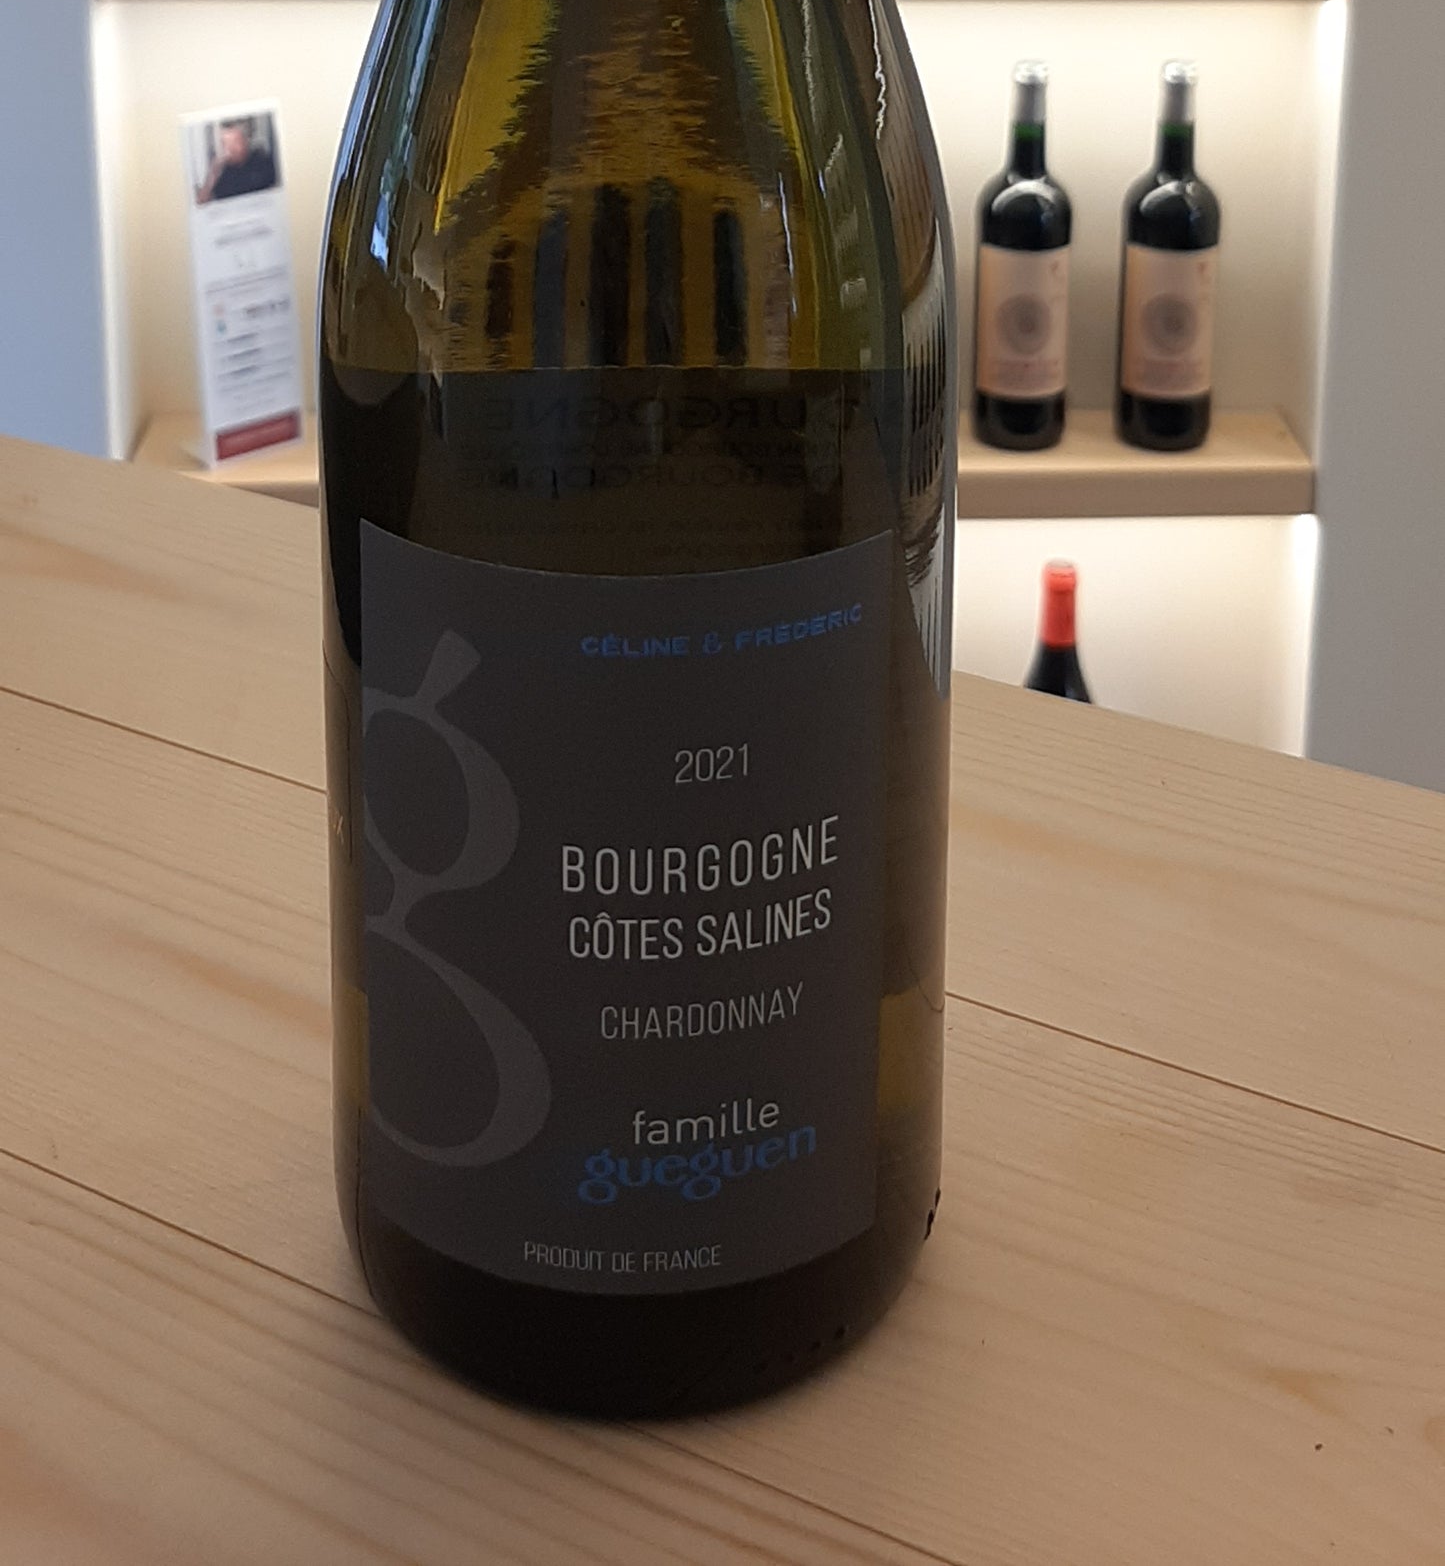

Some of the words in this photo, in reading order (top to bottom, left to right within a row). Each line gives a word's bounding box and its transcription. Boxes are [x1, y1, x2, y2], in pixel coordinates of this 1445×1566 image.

[674, 742, 748, 784] 2021
[561, 814, 839, 896] BOURGOGNE
[568, 911, 683, 960] CÔTES
[696, 887, 832, 957] SALINES
[600, 981, 803, 1040] CHARDONNAY
[632, 1098, 780, 1145] famille
[577, 1124, 817, 1206] gueguen
[524, 1241, 605, 1271] PRODUIT
[612, 1251, 636, 1273] DE
[643, 1245, 722, 1273] FRANCE
